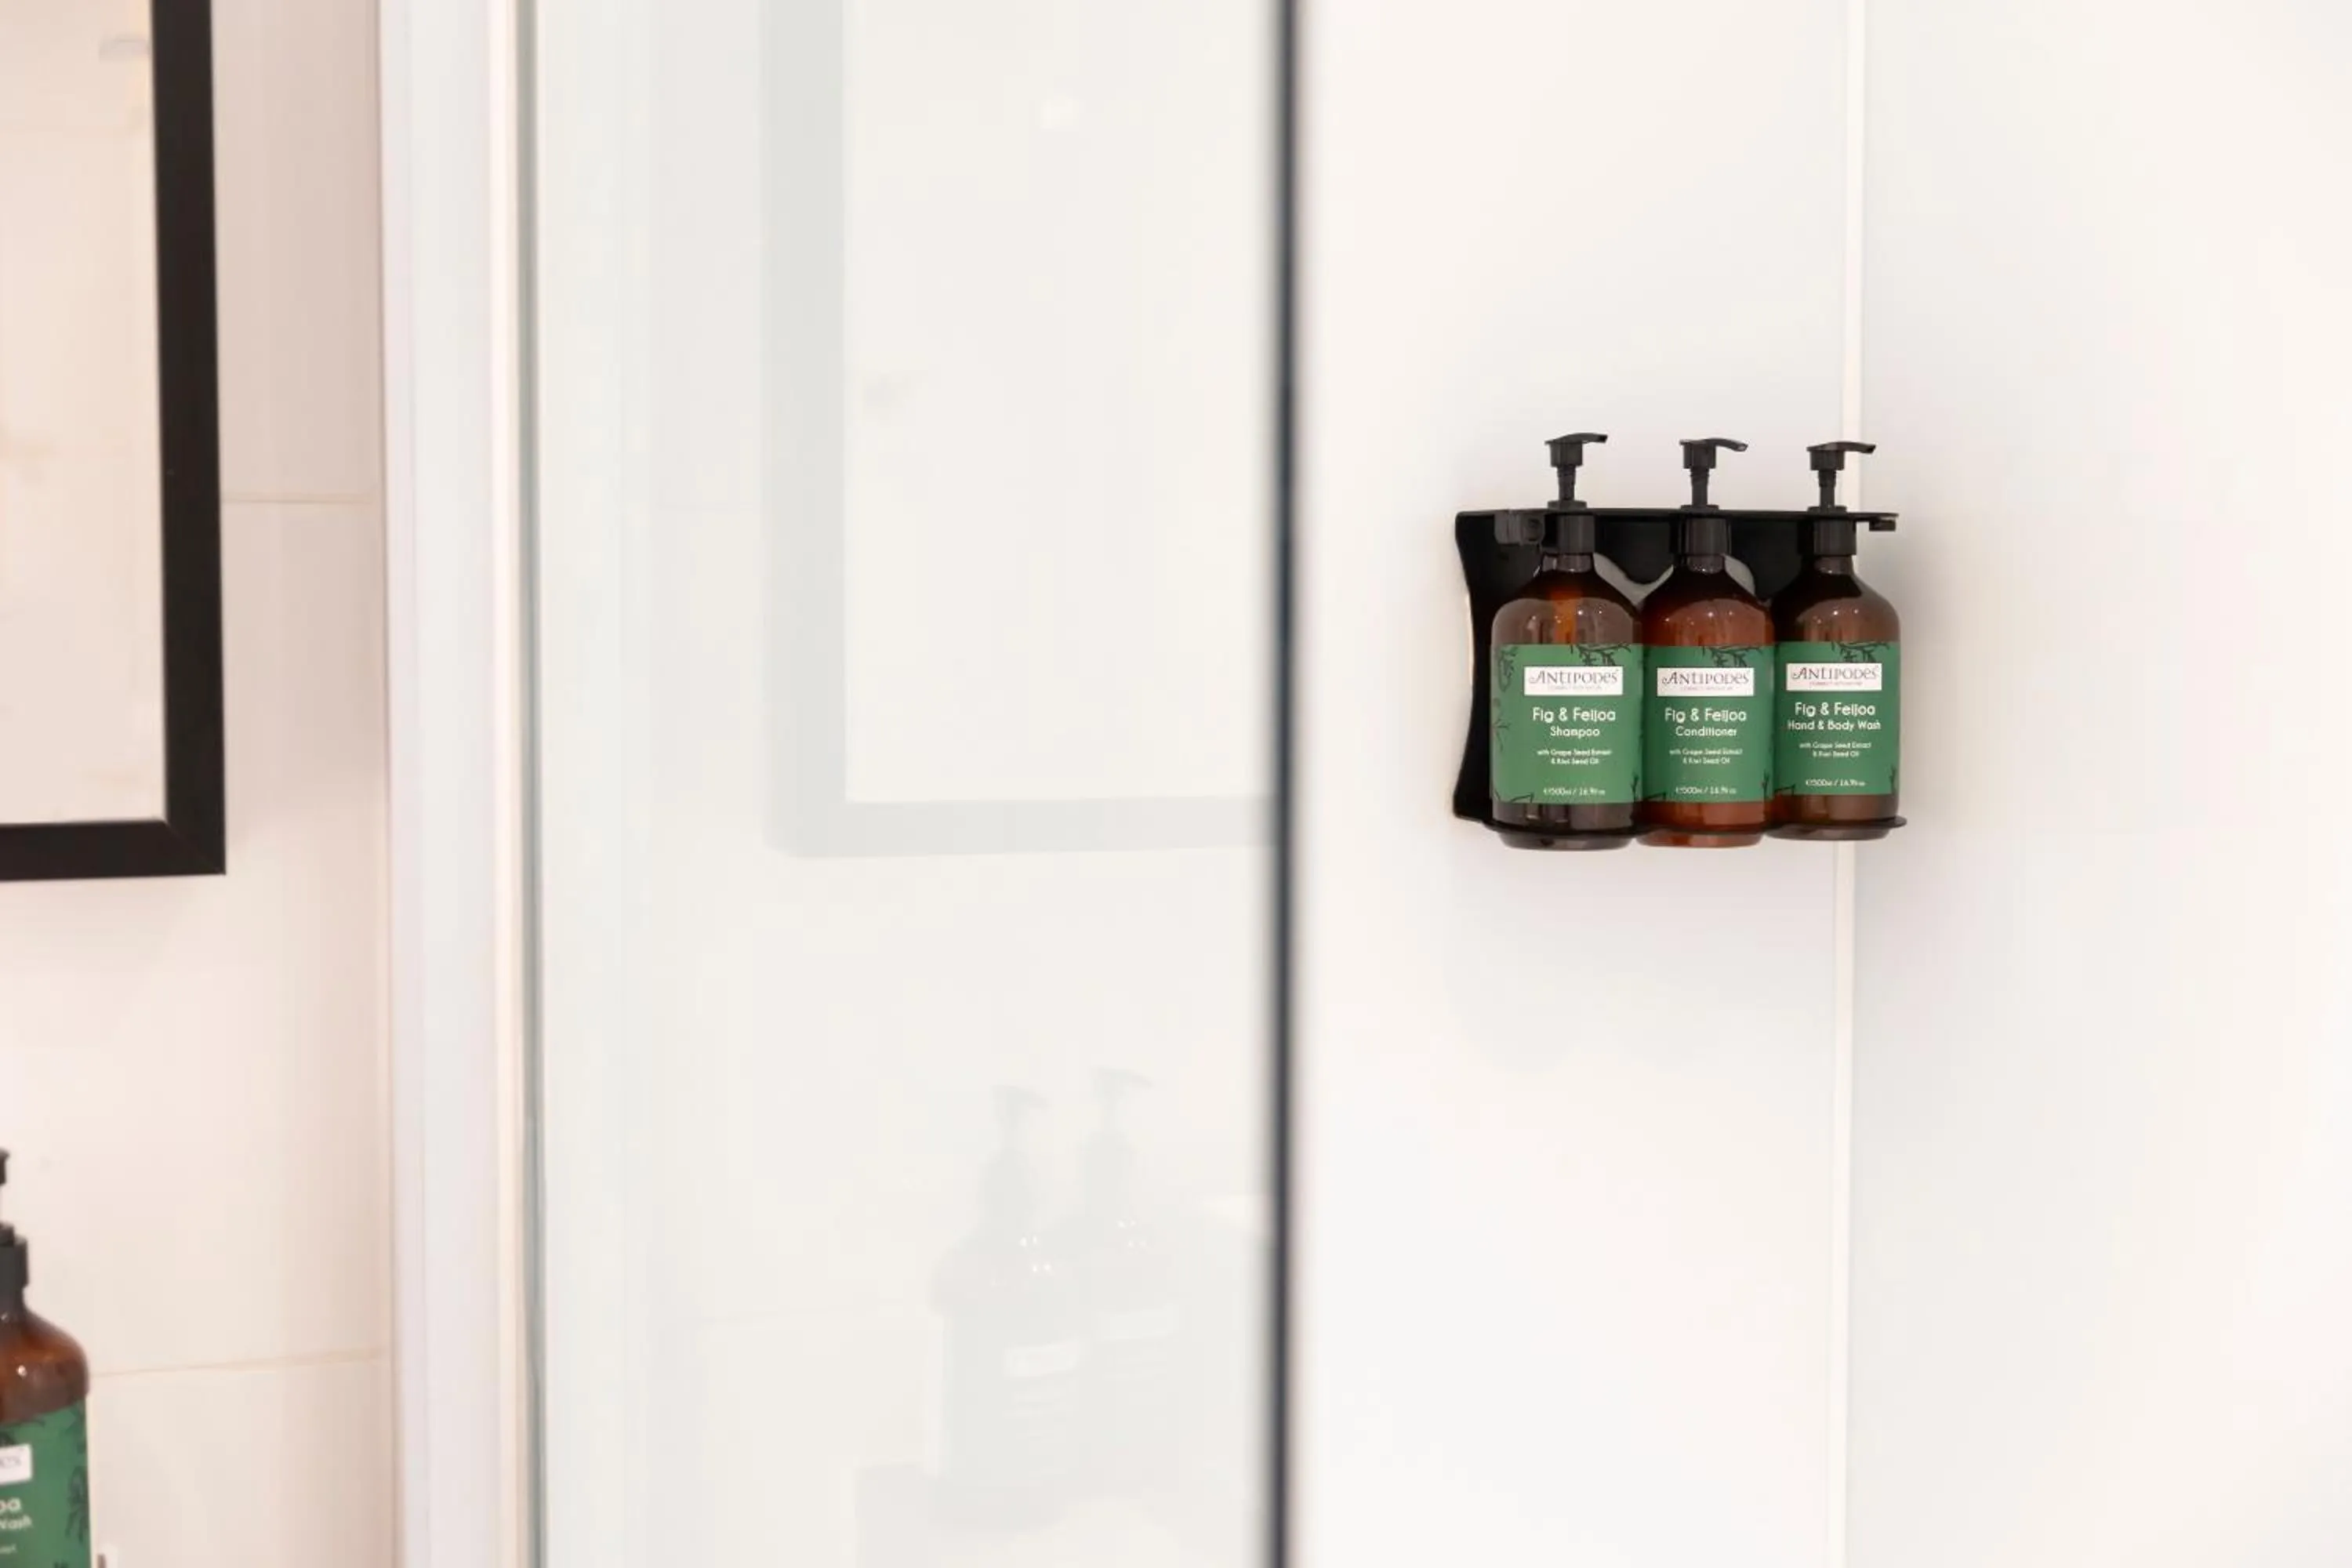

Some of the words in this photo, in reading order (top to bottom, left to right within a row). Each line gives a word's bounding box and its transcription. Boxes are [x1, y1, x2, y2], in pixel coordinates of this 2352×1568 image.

[1532, 706, 1554, 723] Fig
[1559, 707, 1568, 721] &
[1573, 706, 1616, 723] Feijoa
[1664, 707, 1686, 724] Fig
[1690, 708, 1699, 721] &
[1704, 707, 1747, 723] Feijoa
[1795, 702, 1816, 717] Fig
[1820, 702, 1829, 716] &
[1834, 702, 1876, 717] Feijoa
[1550, 725, 1600, 739] Shampoo
[1675, 725, 1737, 736] Conditioner
[1788, 720, 1815, 731] Hand
[1817, 720, 1824, 730] &
[1828, 720, 1855, 732] Body
[1857, 720, 1881, 731] Wash
